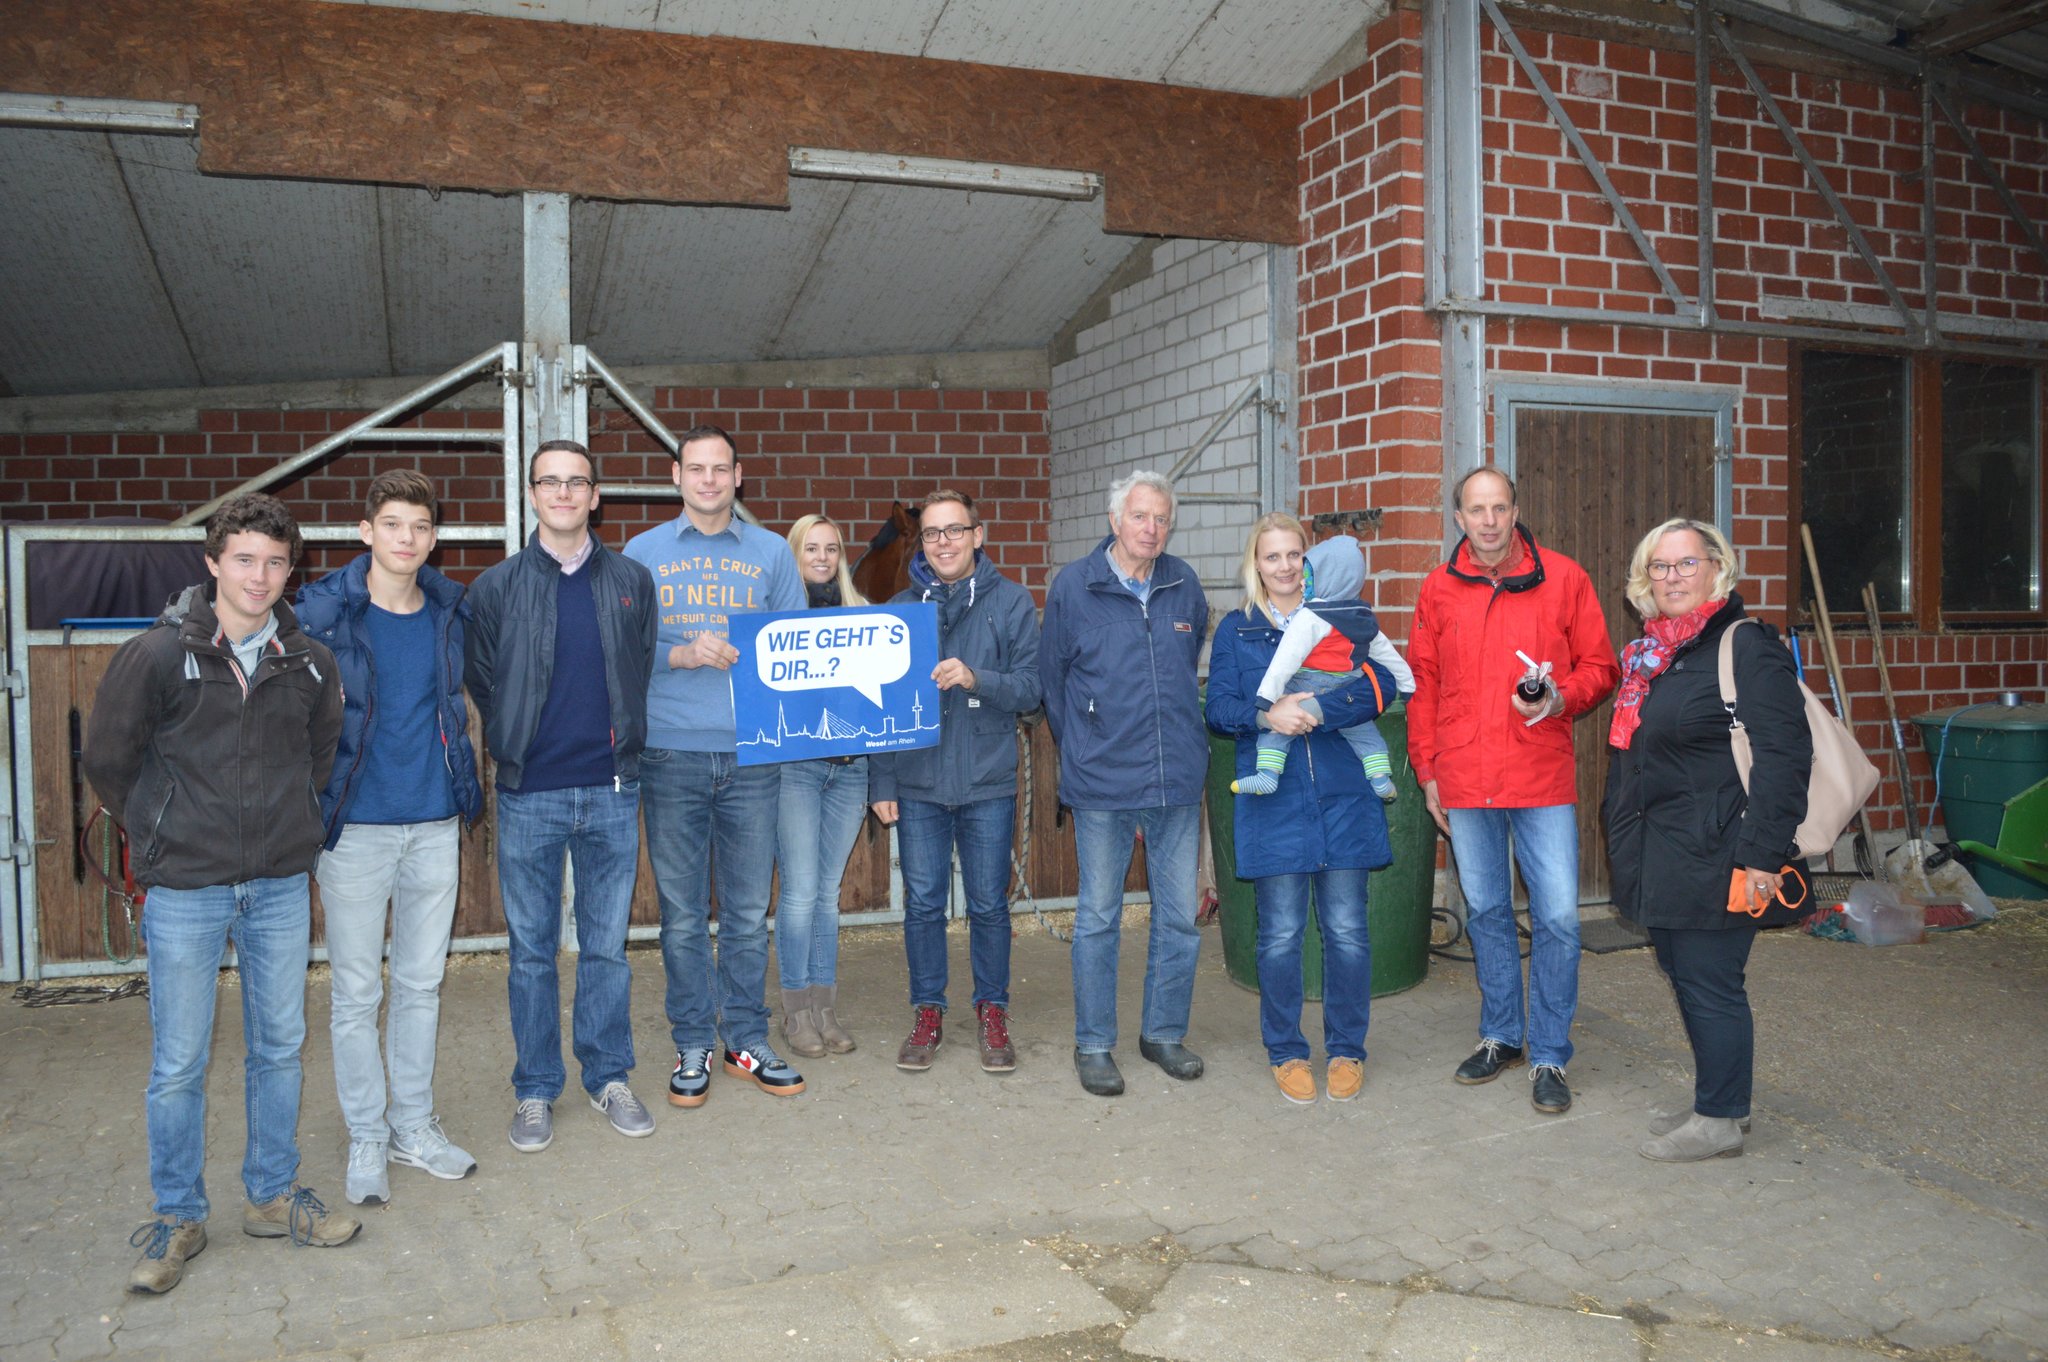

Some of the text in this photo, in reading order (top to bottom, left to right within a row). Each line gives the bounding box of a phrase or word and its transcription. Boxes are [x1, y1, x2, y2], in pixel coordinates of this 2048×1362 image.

[658, 557, 762, 579] SANTA CRUZ
[660, 584, 758, 608] O'NEILL
[662, 613, 706, 625] WETSUIT
[768, 630, 811, 652] WIE
[865, 739, 887, 748] Wesel
[898, 737, 916, 745] Rhein
